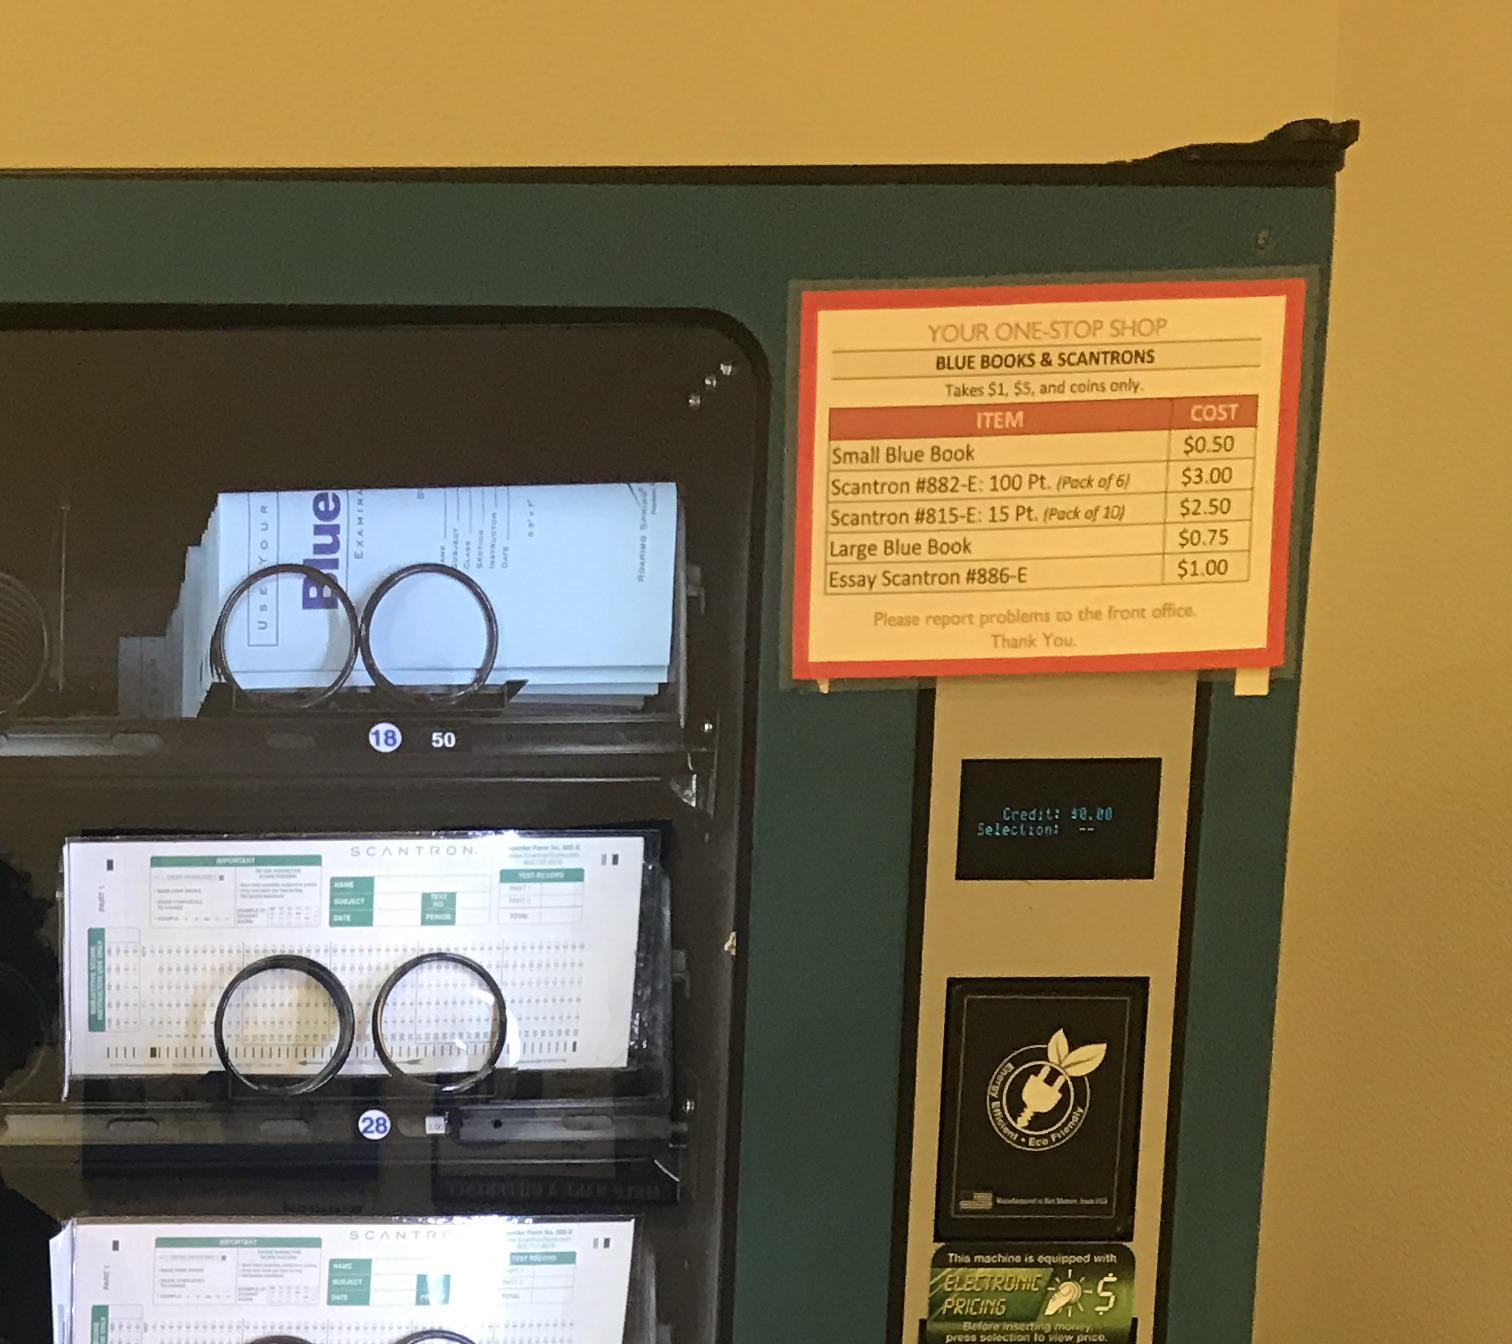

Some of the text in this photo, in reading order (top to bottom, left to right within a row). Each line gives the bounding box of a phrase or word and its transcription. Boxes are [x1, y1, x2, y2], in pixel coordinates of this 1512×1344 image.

[928, 317, 1168, 343] YOUR ONE-STOP SHOP
[936, 349, 1155, 370] BLUE BOOKS & SCANTRONS
[945, 379, 1144, 397] Takes $1, $5, and coins only.
[976, 411, 1024, 429] ITEM
[1191, 404, 1238, 422] COST
[1183, 435, 1234, 454] $0.50
[832, 444, 974, 464] Small Blue Book
[831, 472, 1130, 496] Scantron #882-E: 100 Pt. (Pack of 6)
[1181, 466, 1233, 485] $3.00
[831, 505, 1125, 526] Scantron #815-E: 15 Pt. (Pack of 10)
[1180, 498, 1231, 516] $2.50
[1178, 529, 1229, 547] $0.75
[302, 492, 341, 610] Blue
[829, 538, 972, 560] Large Blue Book
[1177, 559, 1228, 578] $1.00
[829, 568, 1027, 590] Essay Scantron #886-E
[874, 604, 1196, 627] Please report problems to the front office.
[992, 633, 1077, 649] Thank You.
[371, 730, 397, 747] 18
[432, 732, 455, 748] 50
[1003, 807, 1060, 820] Credit:
[978, 824, 1059, 836] Selection:
[351, 846, 474, 856] SCANTRON
[989, 1062, 1015, 1099] Energy
[1029, 1136, 1048, 1147] Eco
[1051, 1106, 1084, 1143] Friendly
[361, 1117, 387, 1134] 28
[948, 1253, 1117, 1265] This machine is equipped with
[943, 1274, 1041, 1292] ELECTRONIC
[942, 1298, 1006, 1315] PRICING
[962, 1322, 1001, 1331] Before
[1003, 1322, 1051, 1333] inserting
[945, 1334, 1108, 1343] press selection to view price.
